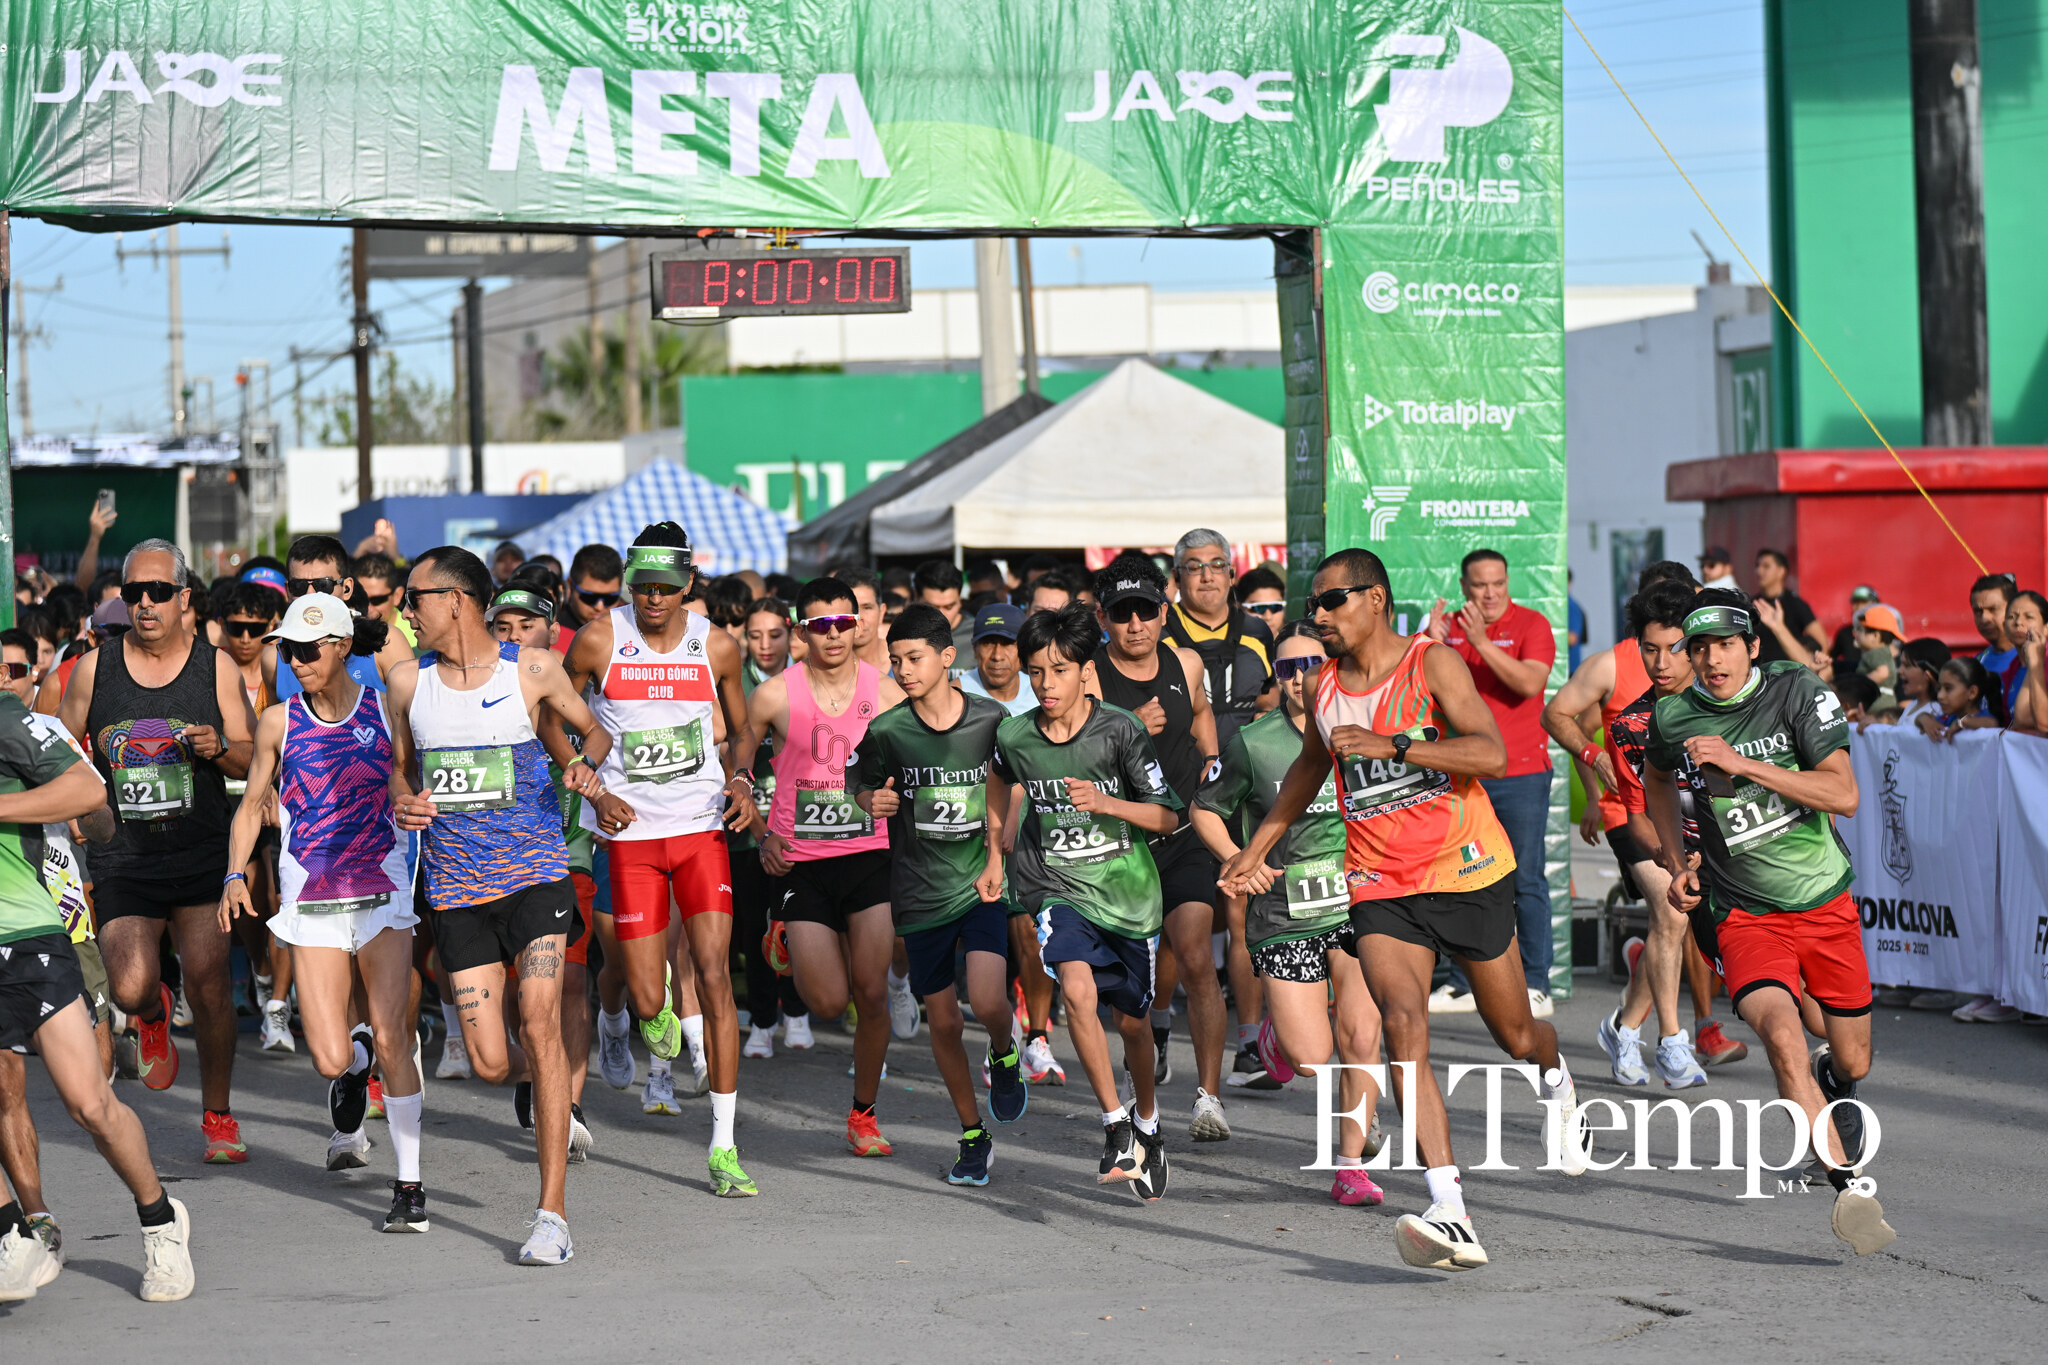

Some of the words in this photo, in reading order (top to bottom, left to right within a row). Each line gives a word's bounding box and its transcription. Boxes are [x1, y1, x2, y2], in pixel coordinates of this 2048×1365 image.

[625, 3, 748, 20] CARRERA
[674, 44, 714, 53] MARZO
[488, 64, 891, 179] META
[1367, 174, 1520, 203] PEÑOLES
[1404, 282, 1521, 303] cimaco
[1398, 399, 1517, 431] Totalplay
[1420, 499, 1530, 517] FRONTERA
[621, 667, 665, 680] RODOLFO
[667, 665, 699, 681] GÓMEZ
[648, 685, 674, 699] CLUB
[641, 727, 675, 736] CARRERA
[634, 740, 687, 768] 225
[695, 730, 703, 764] MEDALLA
[432, 767, 487, 793] 287
[503, 761, 513, 800] MEDALLA
[795, 779, 830, 789] CHRISTIAN
[902, 766, 920, 786] El
[923, 760, 988, 788] Tiempo
[1354, 758, 1407, 788] 146
[122, 780, 167, 804] 321
[183, 773, 191, 808] MEDALLA
[1027, 780, 1047, 800] El
[563, 793, 572, 827] MEDALLA
[804, 803, 853, 825] 269
[933, 801, 967, 823] 22
[1359, 808, 1385, 820] NORA
[1384, 798, 1419, 814] LETICIA
[1420, 785, 1454, 803] ROCHA
[1727, 792, 1787, 833] 314
[1056, 811, 1090, 819] CARRERA
[1050, 824, 1106, 850] 236
[1304, 859, 1336, 869] CARRERA
[1458, 855, 1496, 877] MONCLOVA
[1298, 871, 1348, 901] 118
[1877, 939, 1901, 952] 2025
